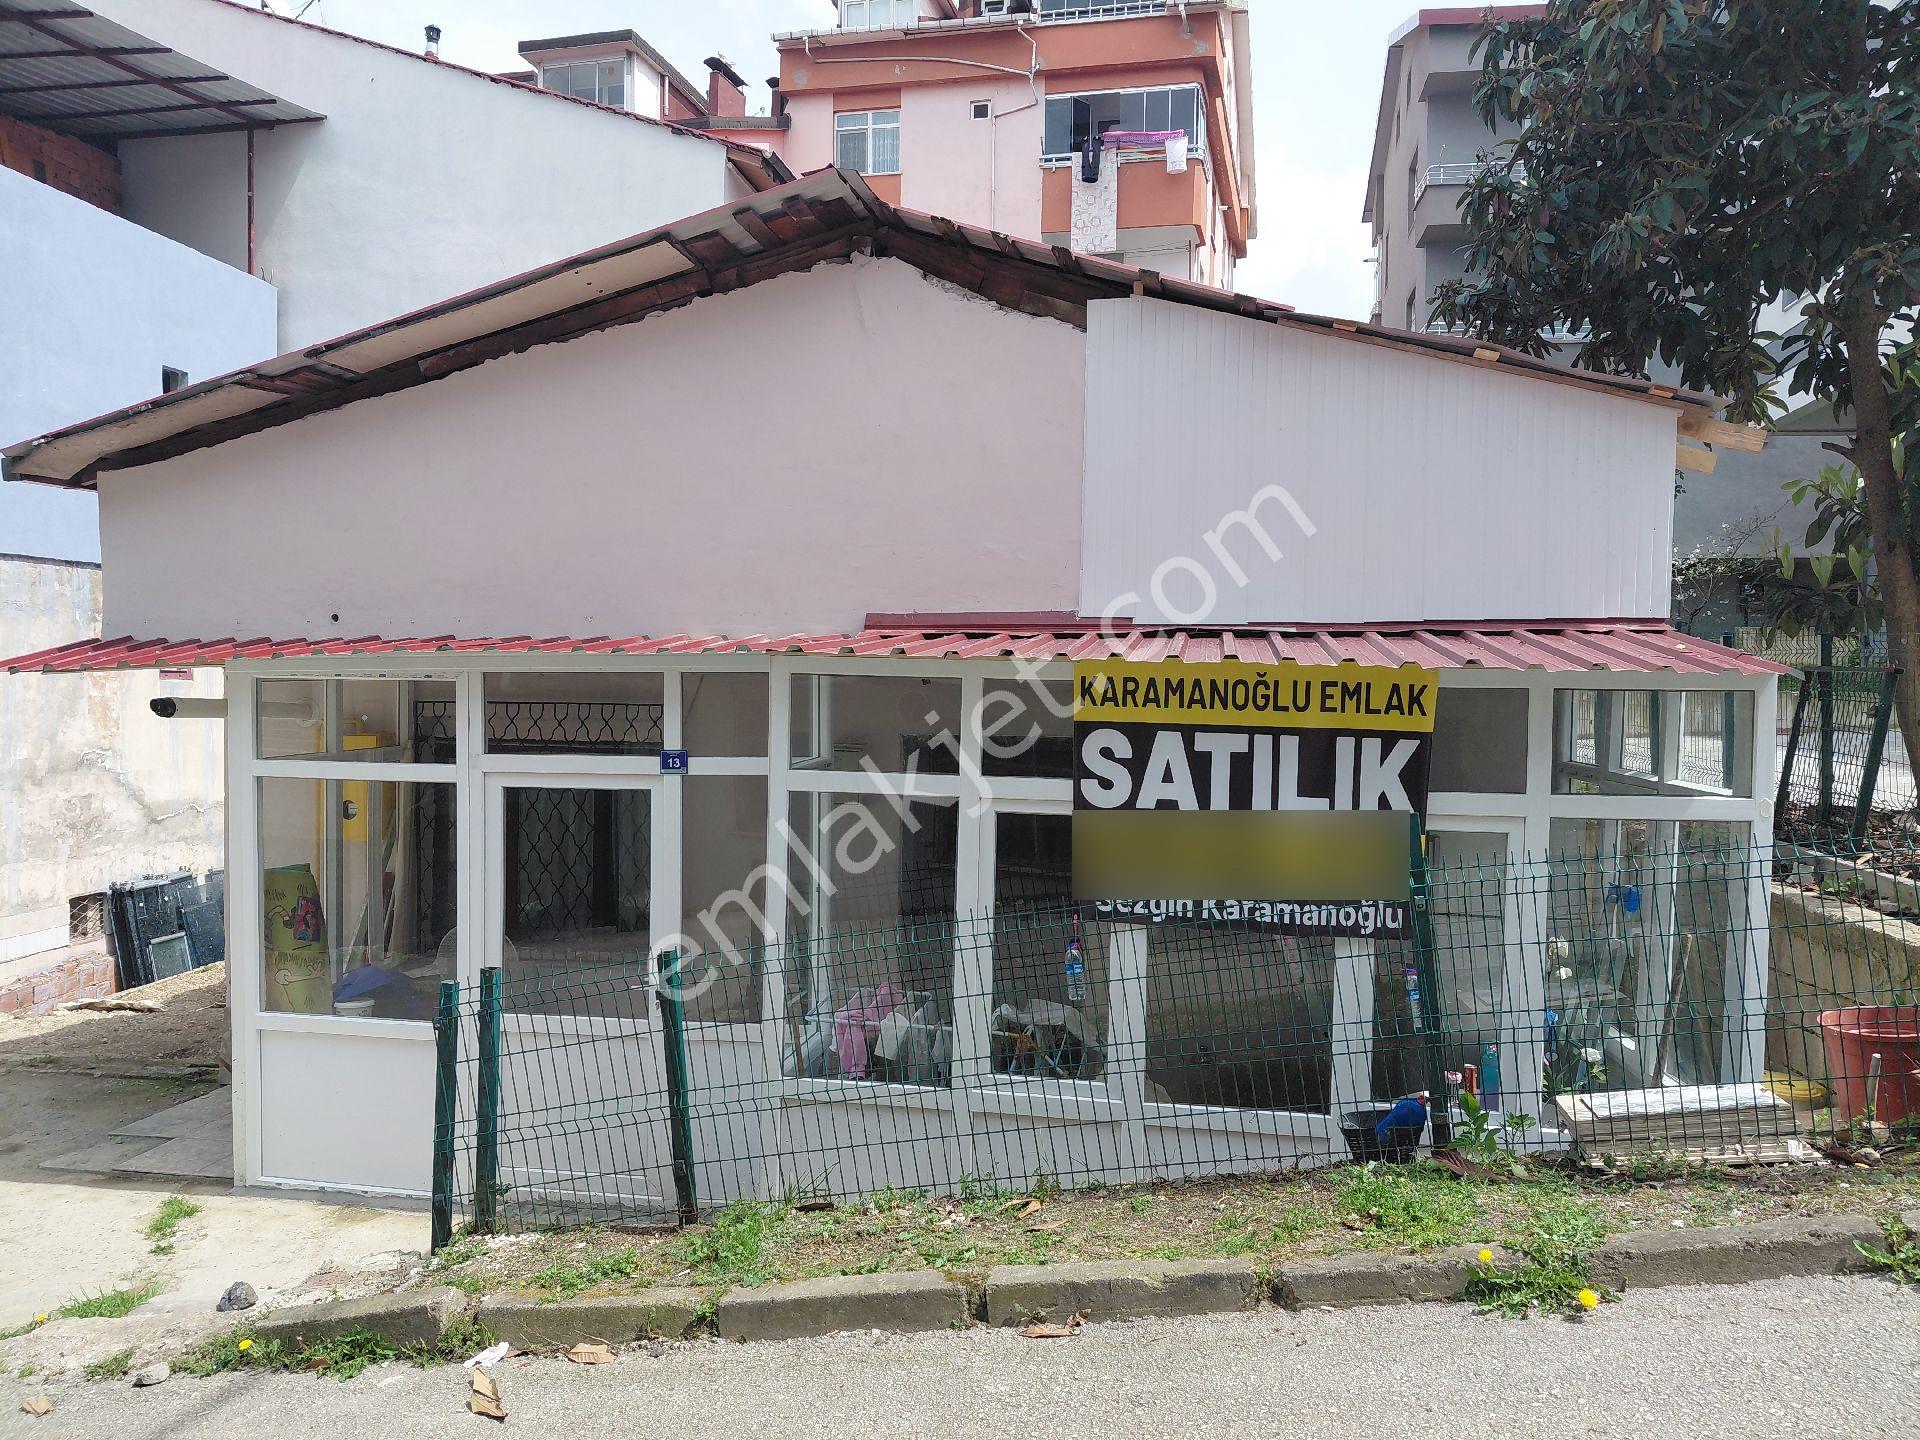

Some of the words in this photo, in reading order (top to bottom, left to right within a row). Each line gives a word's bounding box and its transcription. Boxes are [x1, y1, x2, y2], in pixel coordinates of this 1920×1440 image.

[1079, 671, 1312, 712] KARAMANOĞLU
[1319, 680, 1429, 718] EMLAK
[667, 757, 681, 768] 13
[1080, 728, 1421, 812] SATILIK
[1201, 899, 1404, 935] Karamanoğlu
